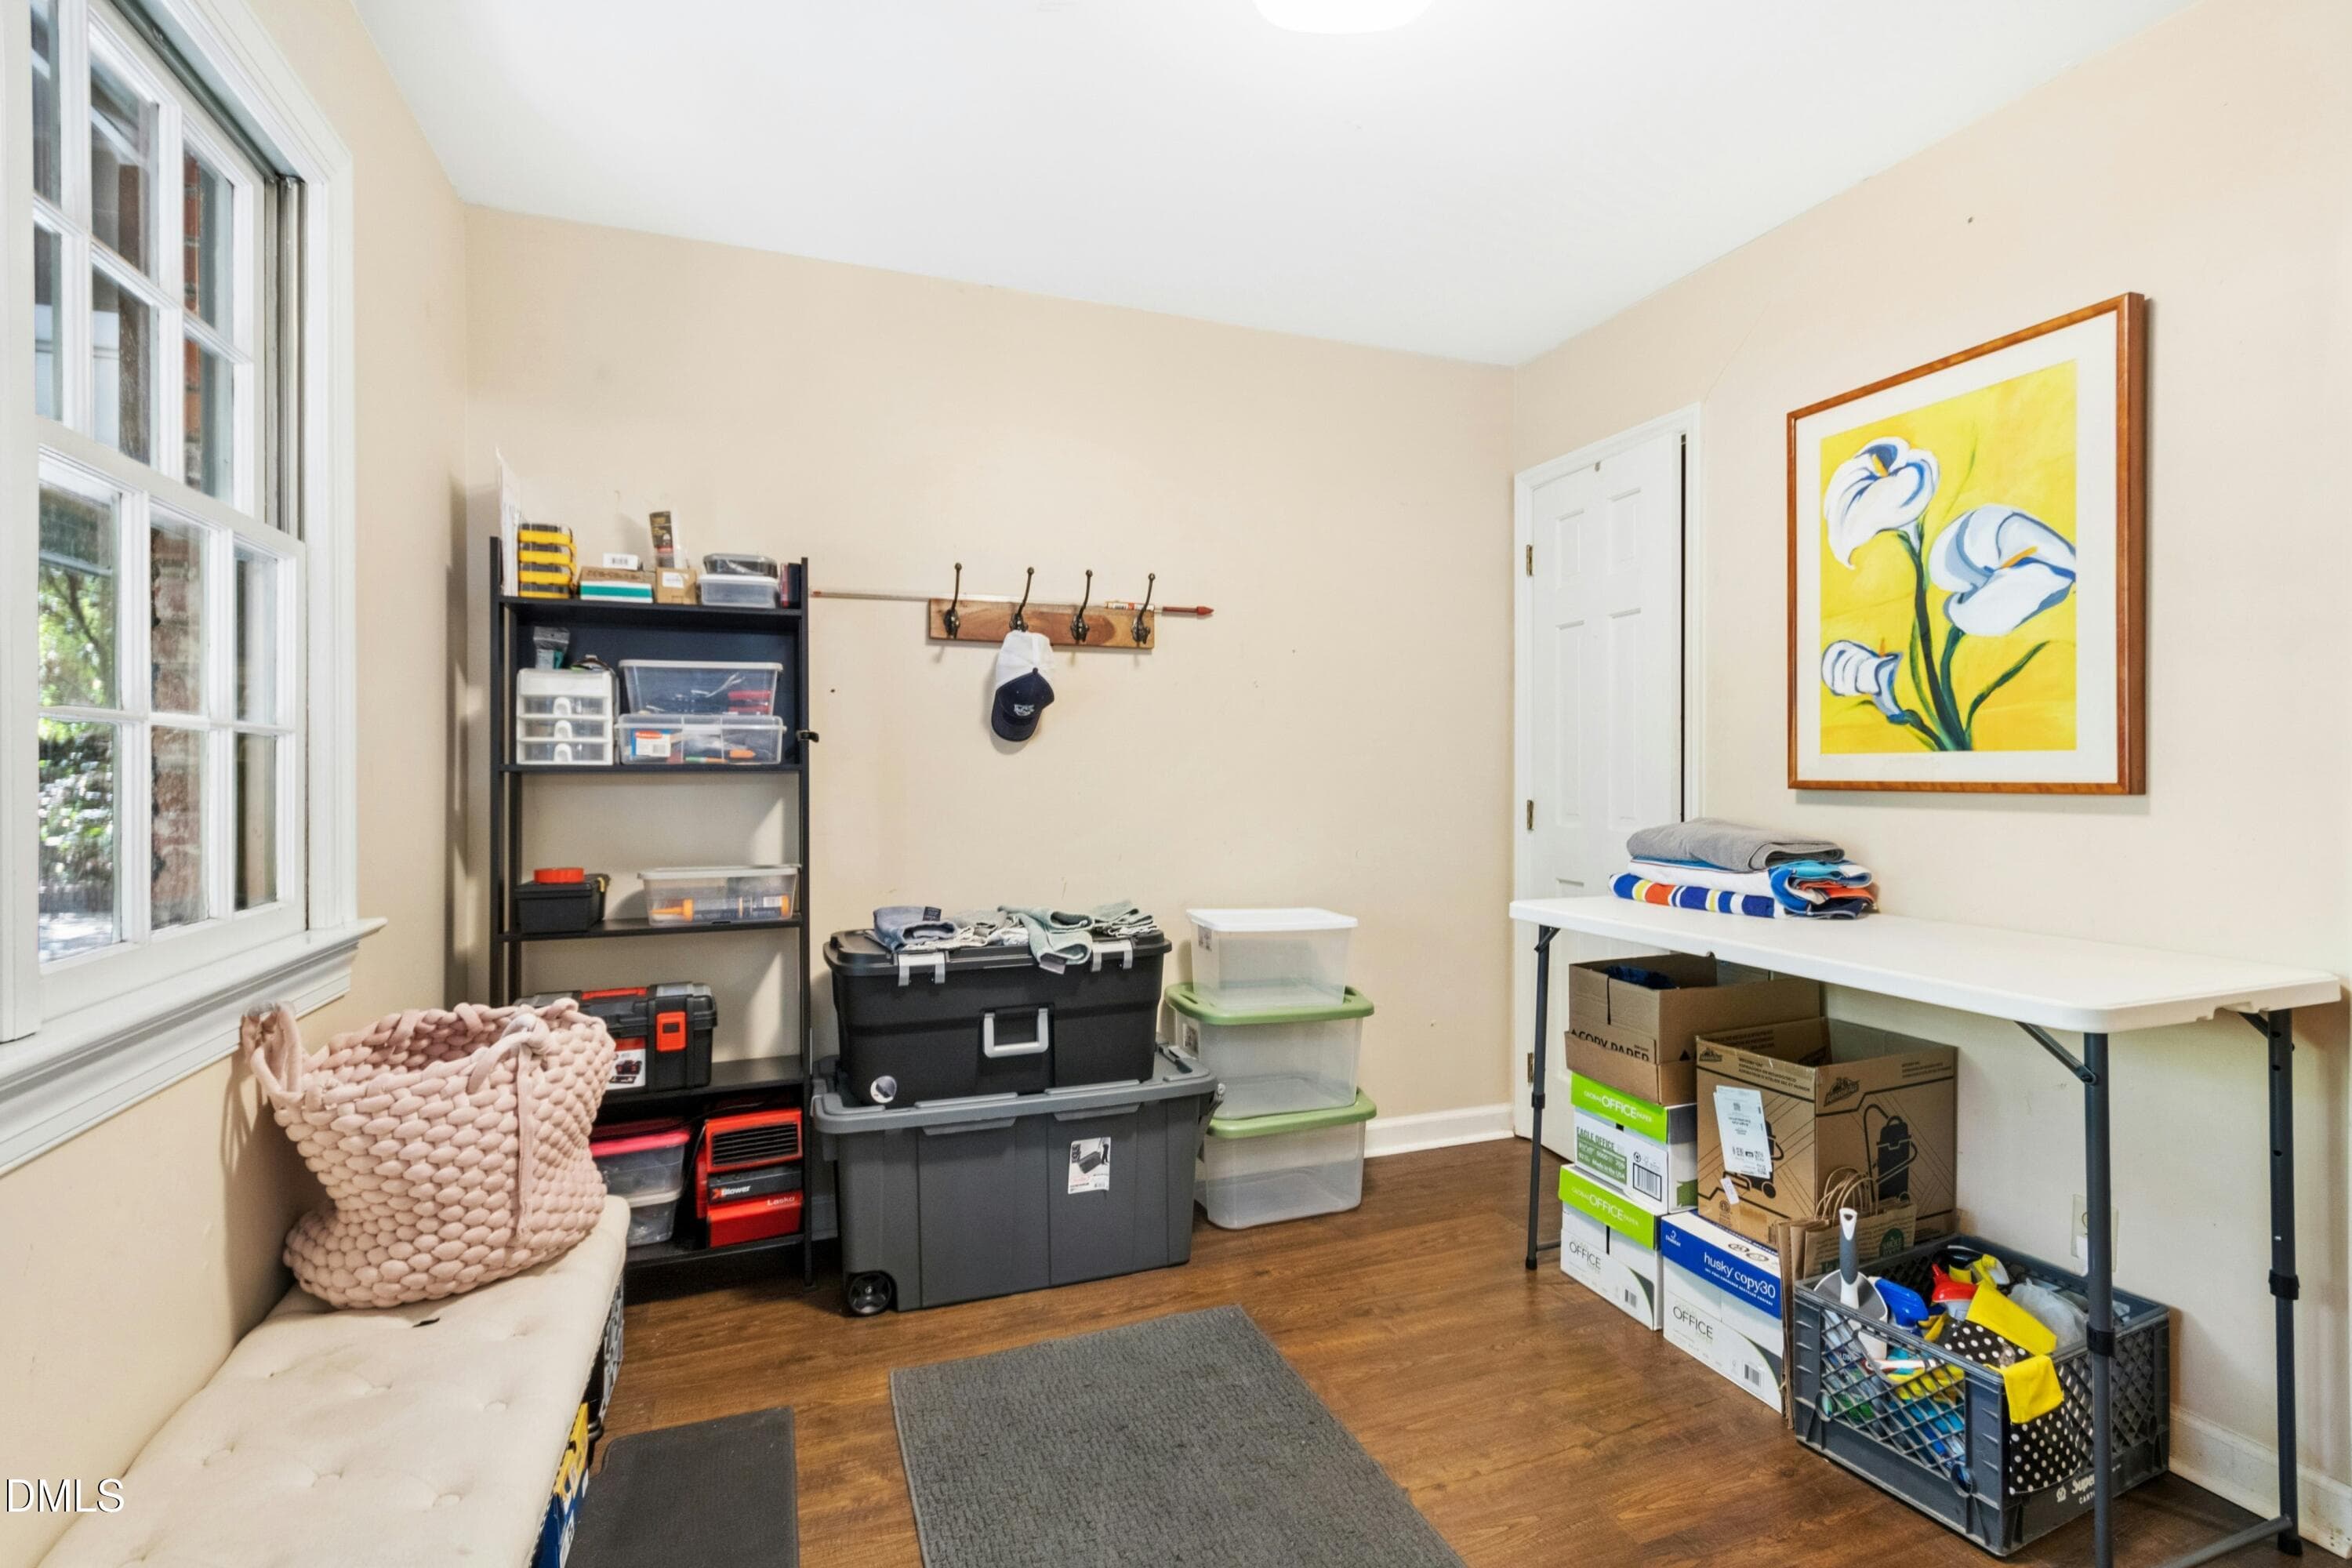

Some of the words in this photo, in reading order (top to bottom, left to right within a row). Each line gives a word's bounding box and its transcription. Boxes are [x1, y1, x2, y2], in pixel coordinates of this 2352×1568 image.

[1602, 1094, 1637, 1120] OFFICE
[767, 1196, 796, 1207] Lasko
[1589, 1194, 1623, 1221] OFFICE
[1570, 1241, 1601, 1270] OFFICE
[1704, 1252, 1733, 1277] husky
[1734, 1271, 1776, 1298] copy30
[1673, 1305, 1713, 1340] OFFICE
